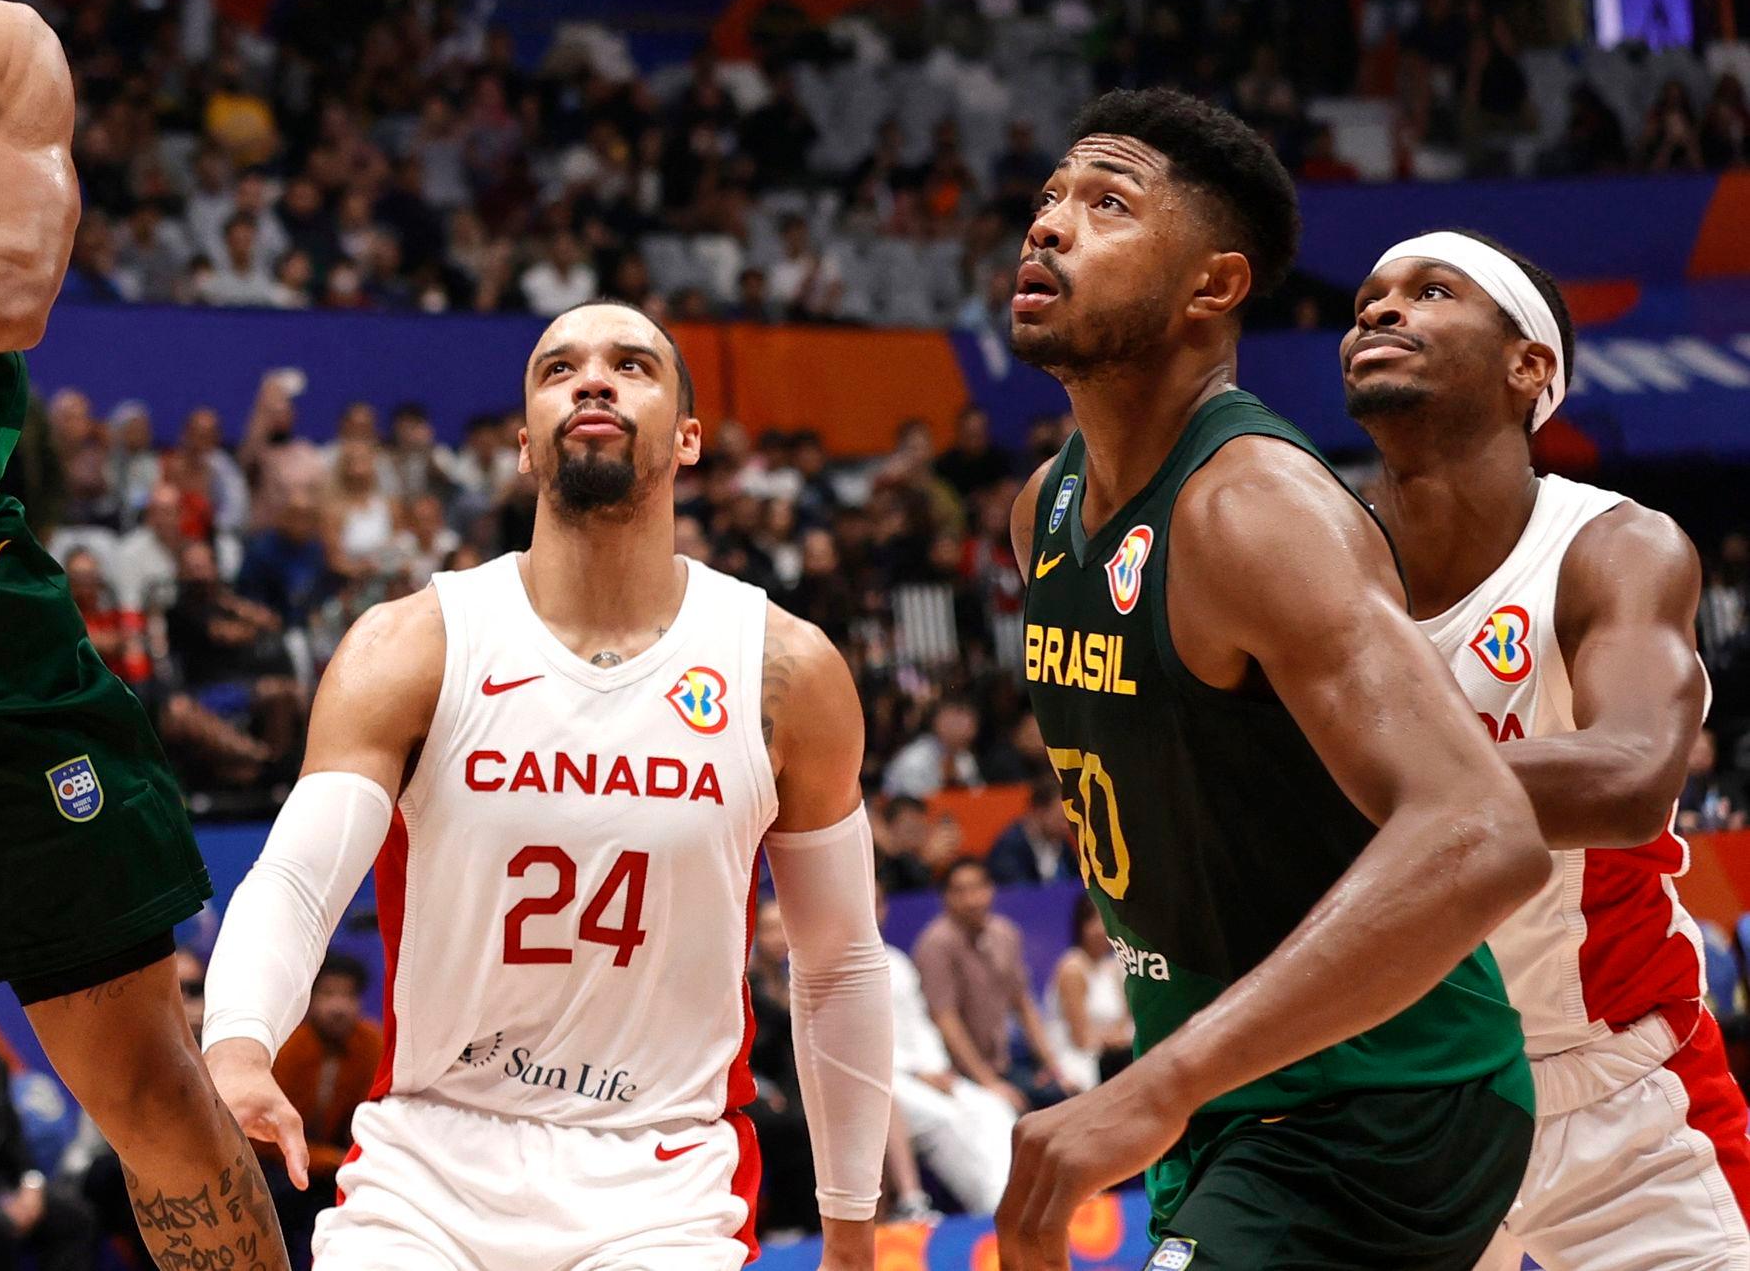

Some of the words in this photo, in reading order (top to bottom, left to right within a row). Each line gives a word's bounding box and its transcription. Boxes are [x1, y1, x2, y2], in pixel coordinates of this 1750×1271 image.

[1025, 622, 1138, 697] BRASIL
[464, 749, 725, 806] CANADA
[503, 845, 650, 967] 24
[503, 1046, 568, 1091] Sun
[573, 1061, 638, 1104] Life
